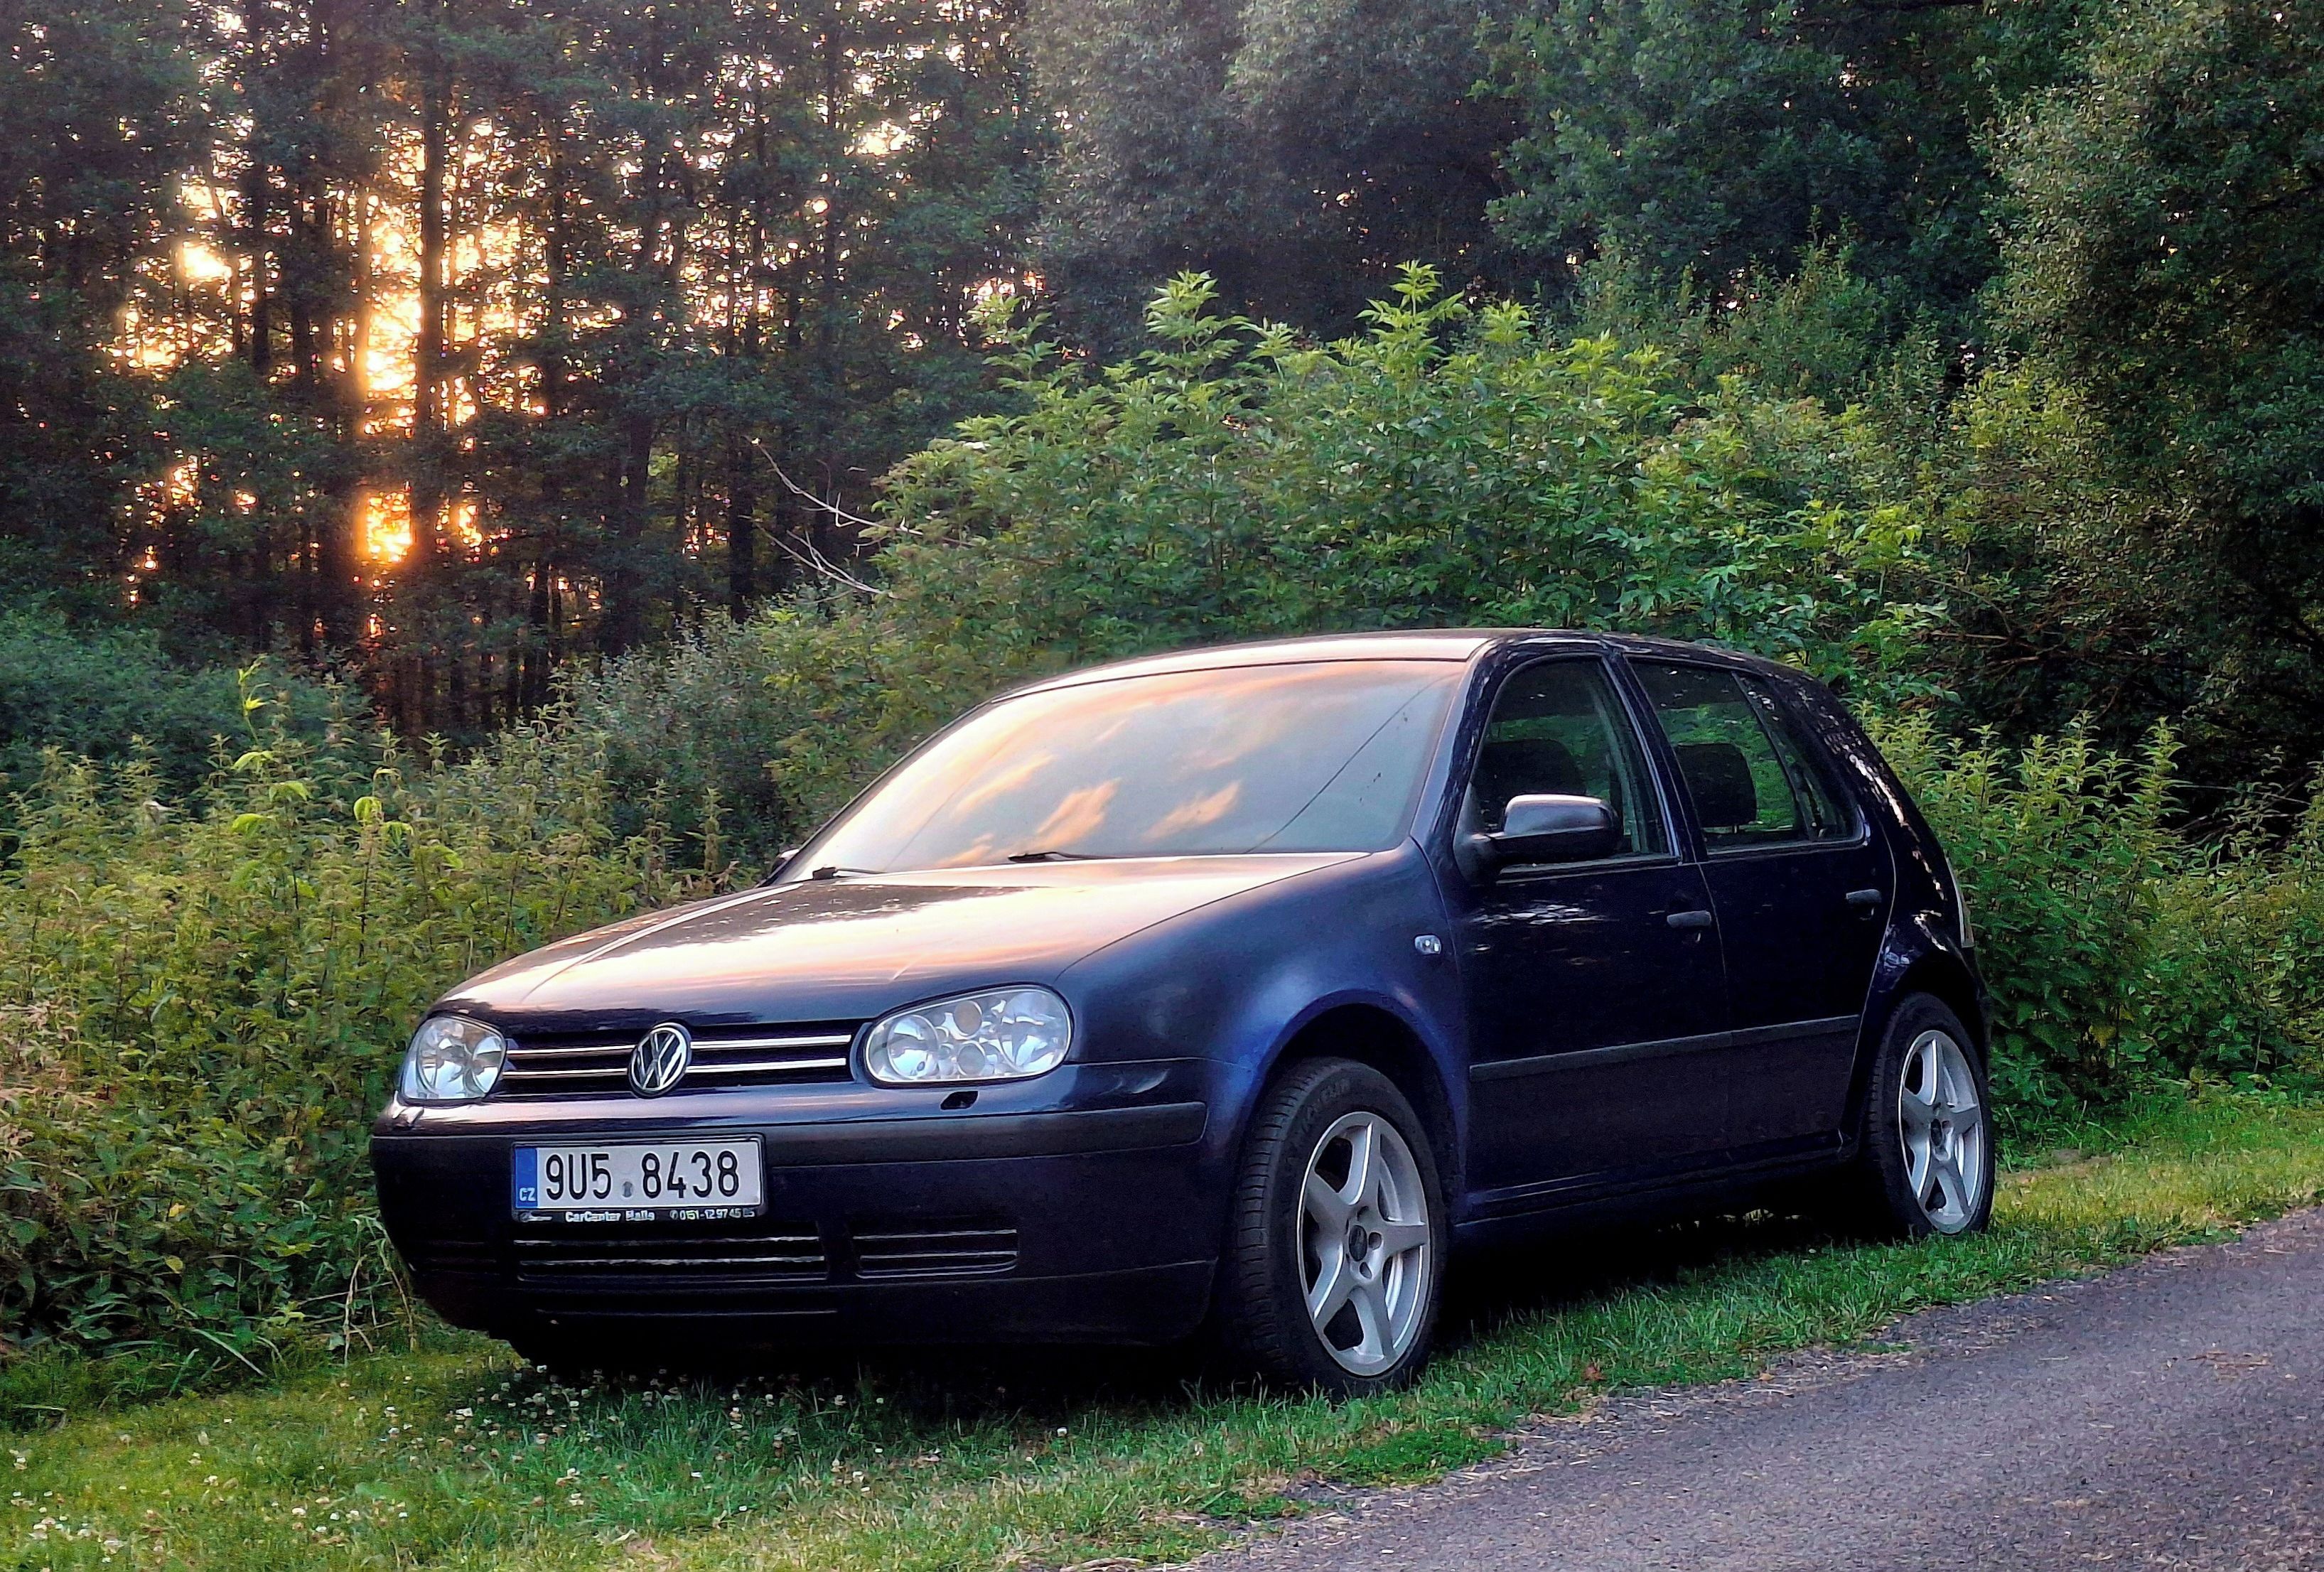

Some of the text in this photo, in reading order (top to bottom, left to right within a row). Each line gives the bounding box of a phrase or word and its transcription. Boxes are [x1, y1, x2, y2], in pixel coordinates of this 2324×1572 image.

[545, 1150, 740, 1200] 9U5 8438
[519, 1187, 537, 1201] CZ
